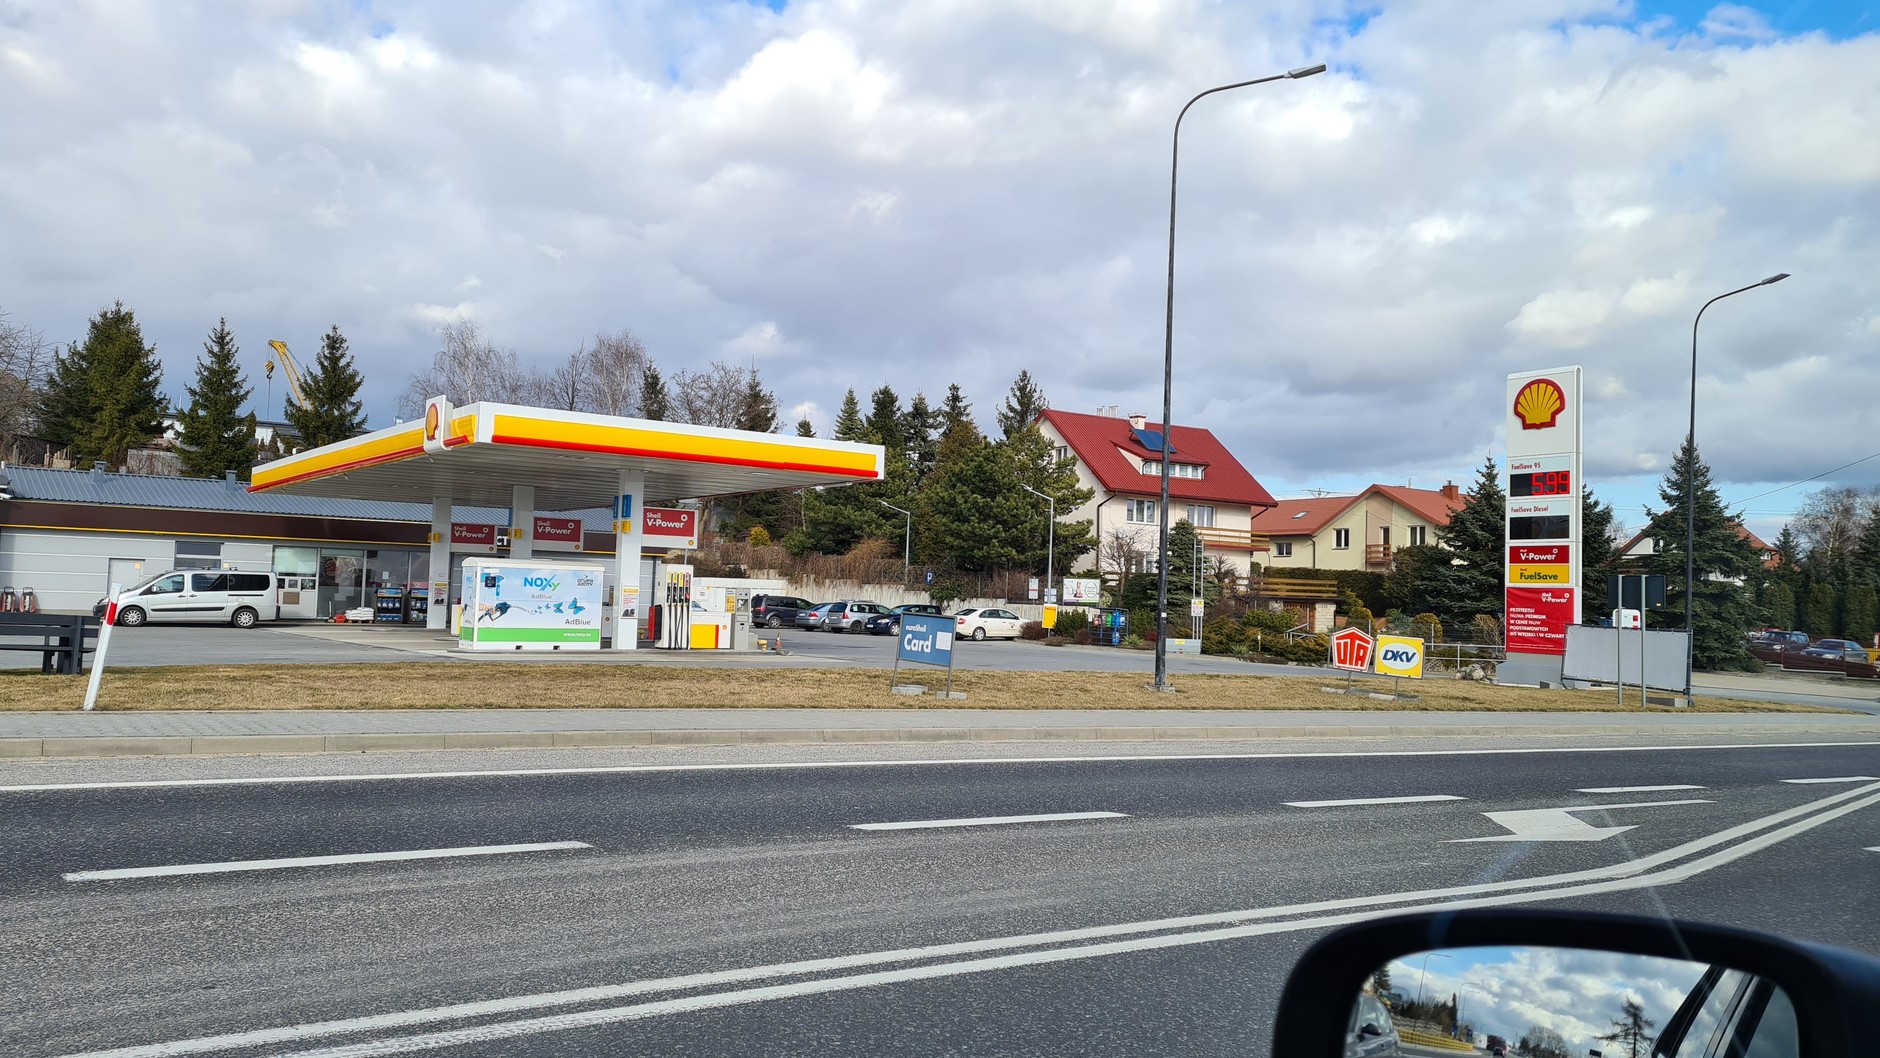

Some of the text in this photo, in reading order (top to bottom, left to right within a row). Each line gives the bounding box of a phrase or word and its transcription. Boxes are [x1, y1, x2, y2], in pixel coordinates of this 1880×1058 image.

[1511, 505, 1532, 513] FuelSave
[646, 518, 685, 529] V-Power
[454, 530, 487, 538] V-Power
[537, 526, 572, 535] V-Power
[1520, 552, 1556, 560] V-Power
[927, 572, 933, 582] P
[1520, 571, 1558, 580] FuelSave
[565, 618, 592, 626] AdBlue
[905, 623, 927, 633] euroShell
[903, 633, 933, 653] Card
[1336, 632, 1372, 668] UTA
[1382, 649, 1417, 663] DKV
